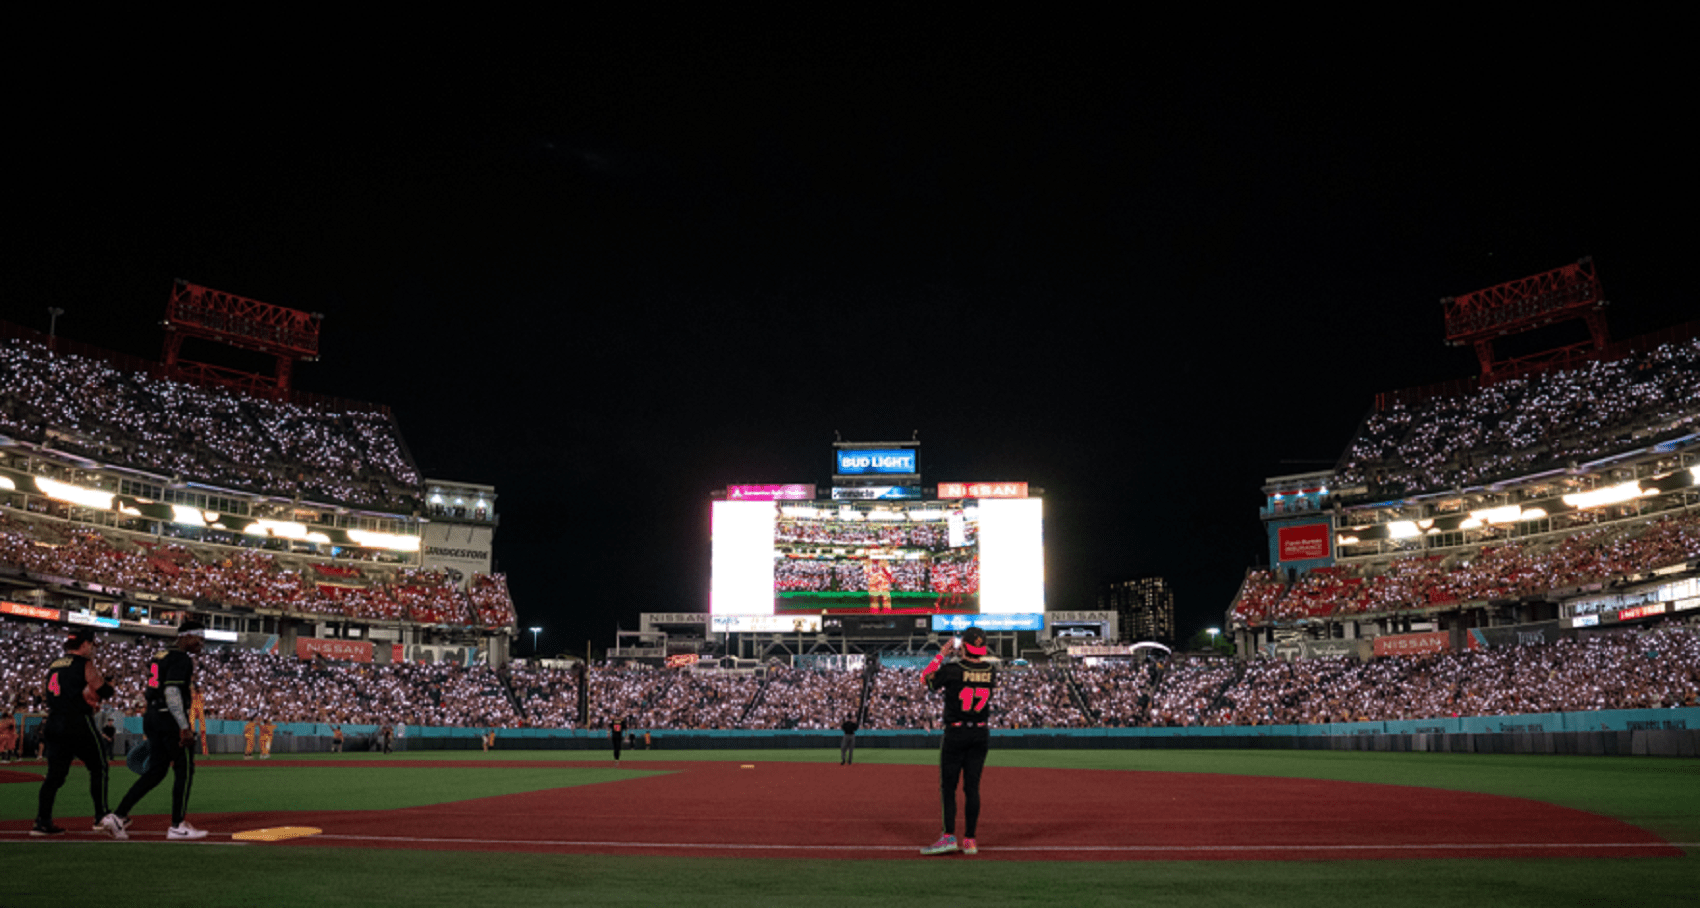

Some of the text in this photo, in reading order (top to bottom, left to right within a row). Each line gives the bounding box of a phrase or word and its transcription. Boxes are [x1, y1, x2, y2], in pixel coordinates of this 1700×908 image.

[842, 456, 911, 468] BUD LIGHT
[948, 483, 1018, 496] NISSAN
[1051, 612, 1109, 620] NISSAN
[306, 642, 365, 655] NISSAN
[1382, 638, 1441, 650] NISSAN
[963, 670, 992, 683] PONCE
[48, 672, 61, 697] 4
[959, 687, 990, 712] 17
